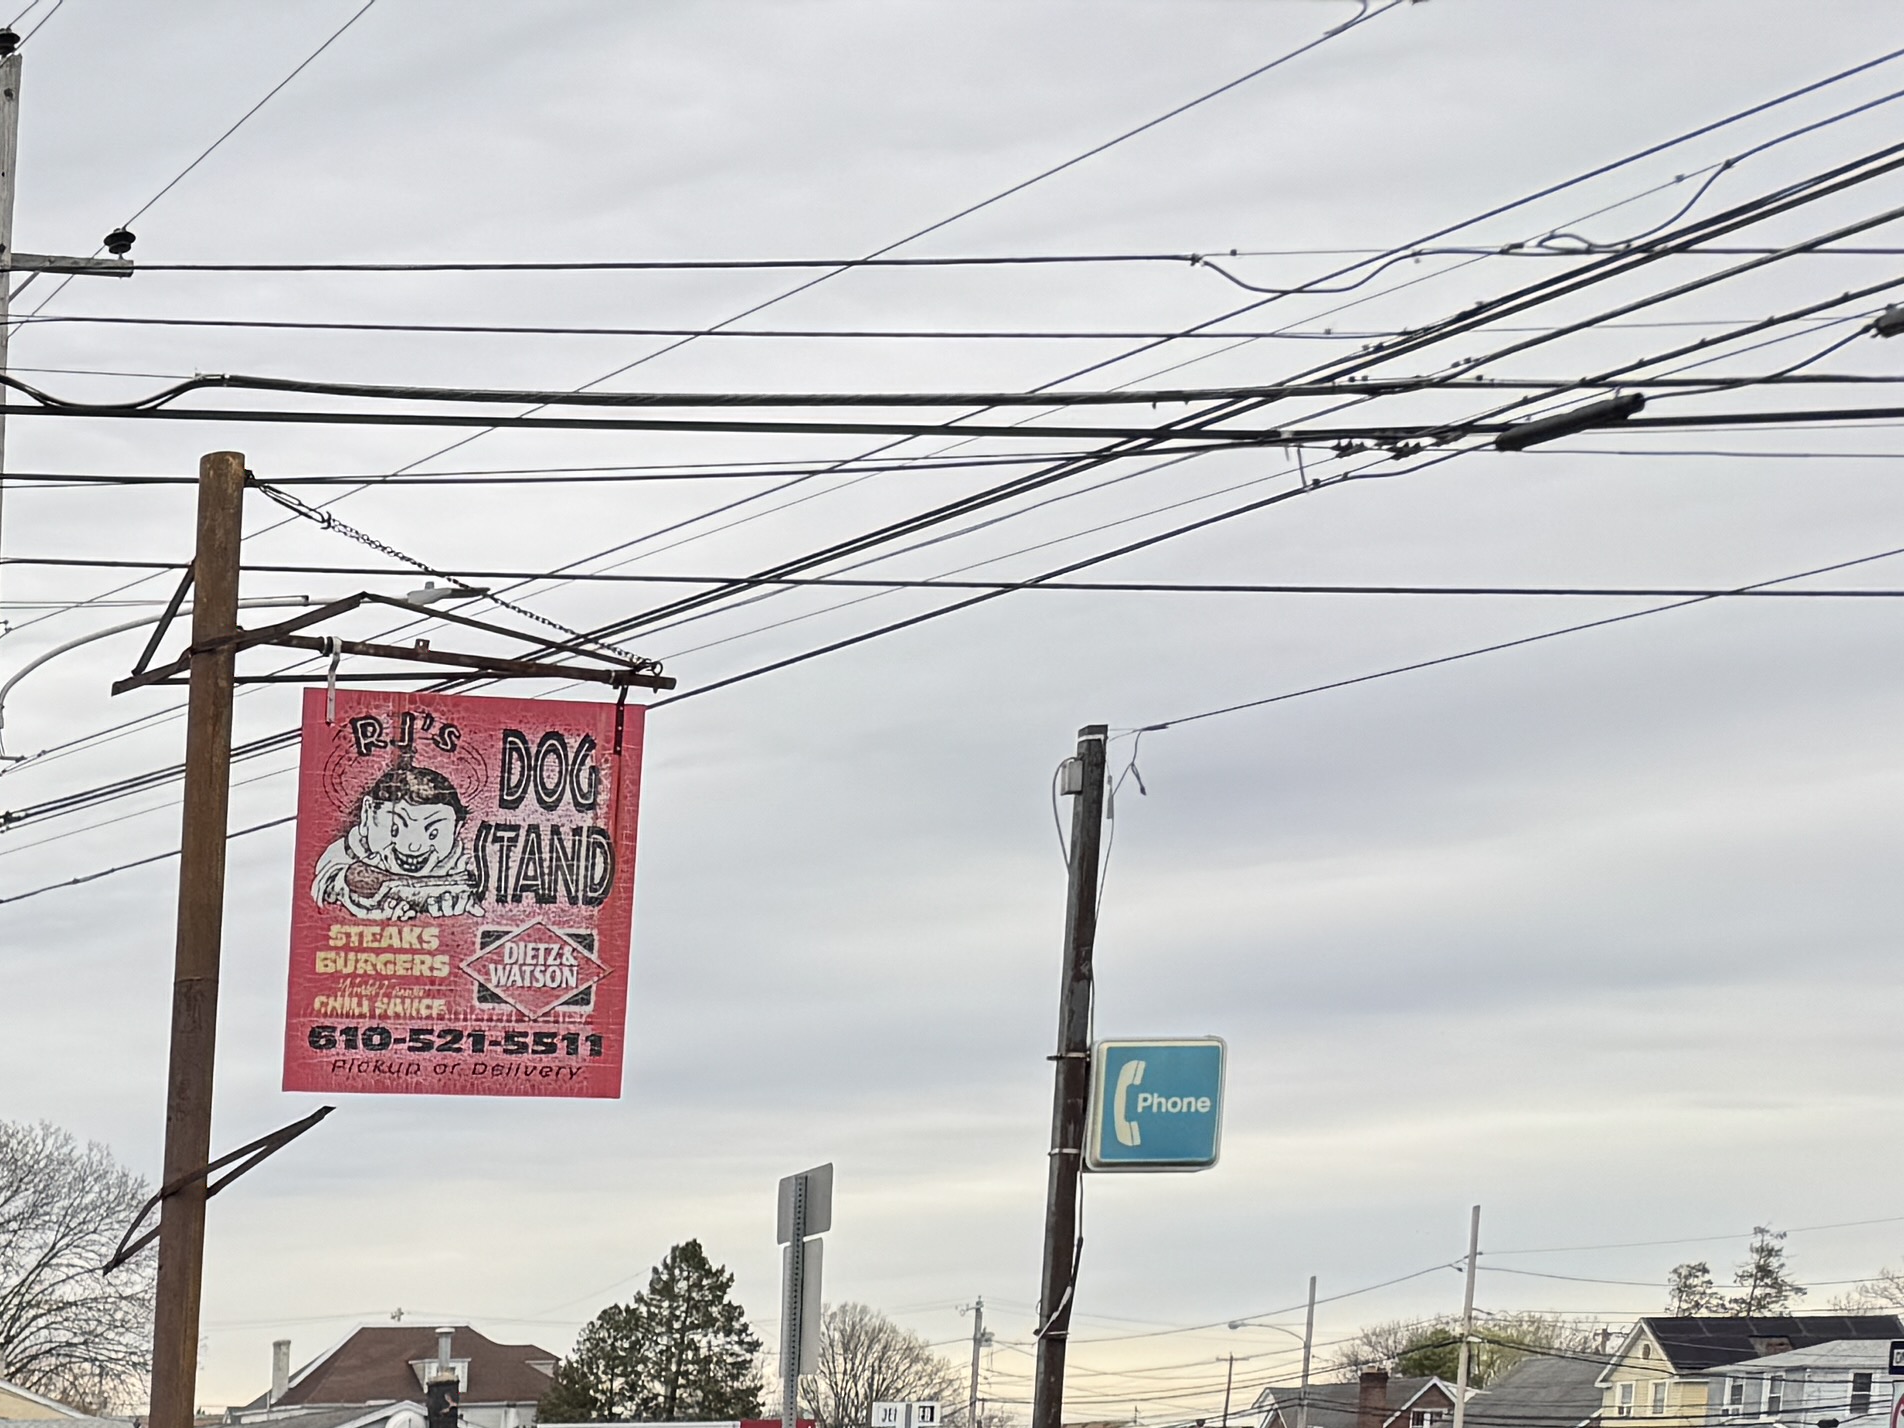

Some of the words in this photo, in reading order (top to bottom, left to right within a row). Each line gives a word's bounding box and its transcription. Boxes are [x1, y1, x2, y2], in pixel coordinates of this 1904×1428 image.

[498, 728, 601, 812] DOG
[470, 820, 616, 906] STAND
[328, 924, 440, 950] STEAKS
[315, 951, 451, 977] BURGERS
[489, 963, 578, 988] WATSON
[314, 995, 369, 1015] CHILI
[375, 997, 448, 1018] SAUCE
[307, 1025, 604, 1057] 610-521-5511
[433, 1061, 461, 1075] or
[1136, 1092, 1211, 1114] Phone
